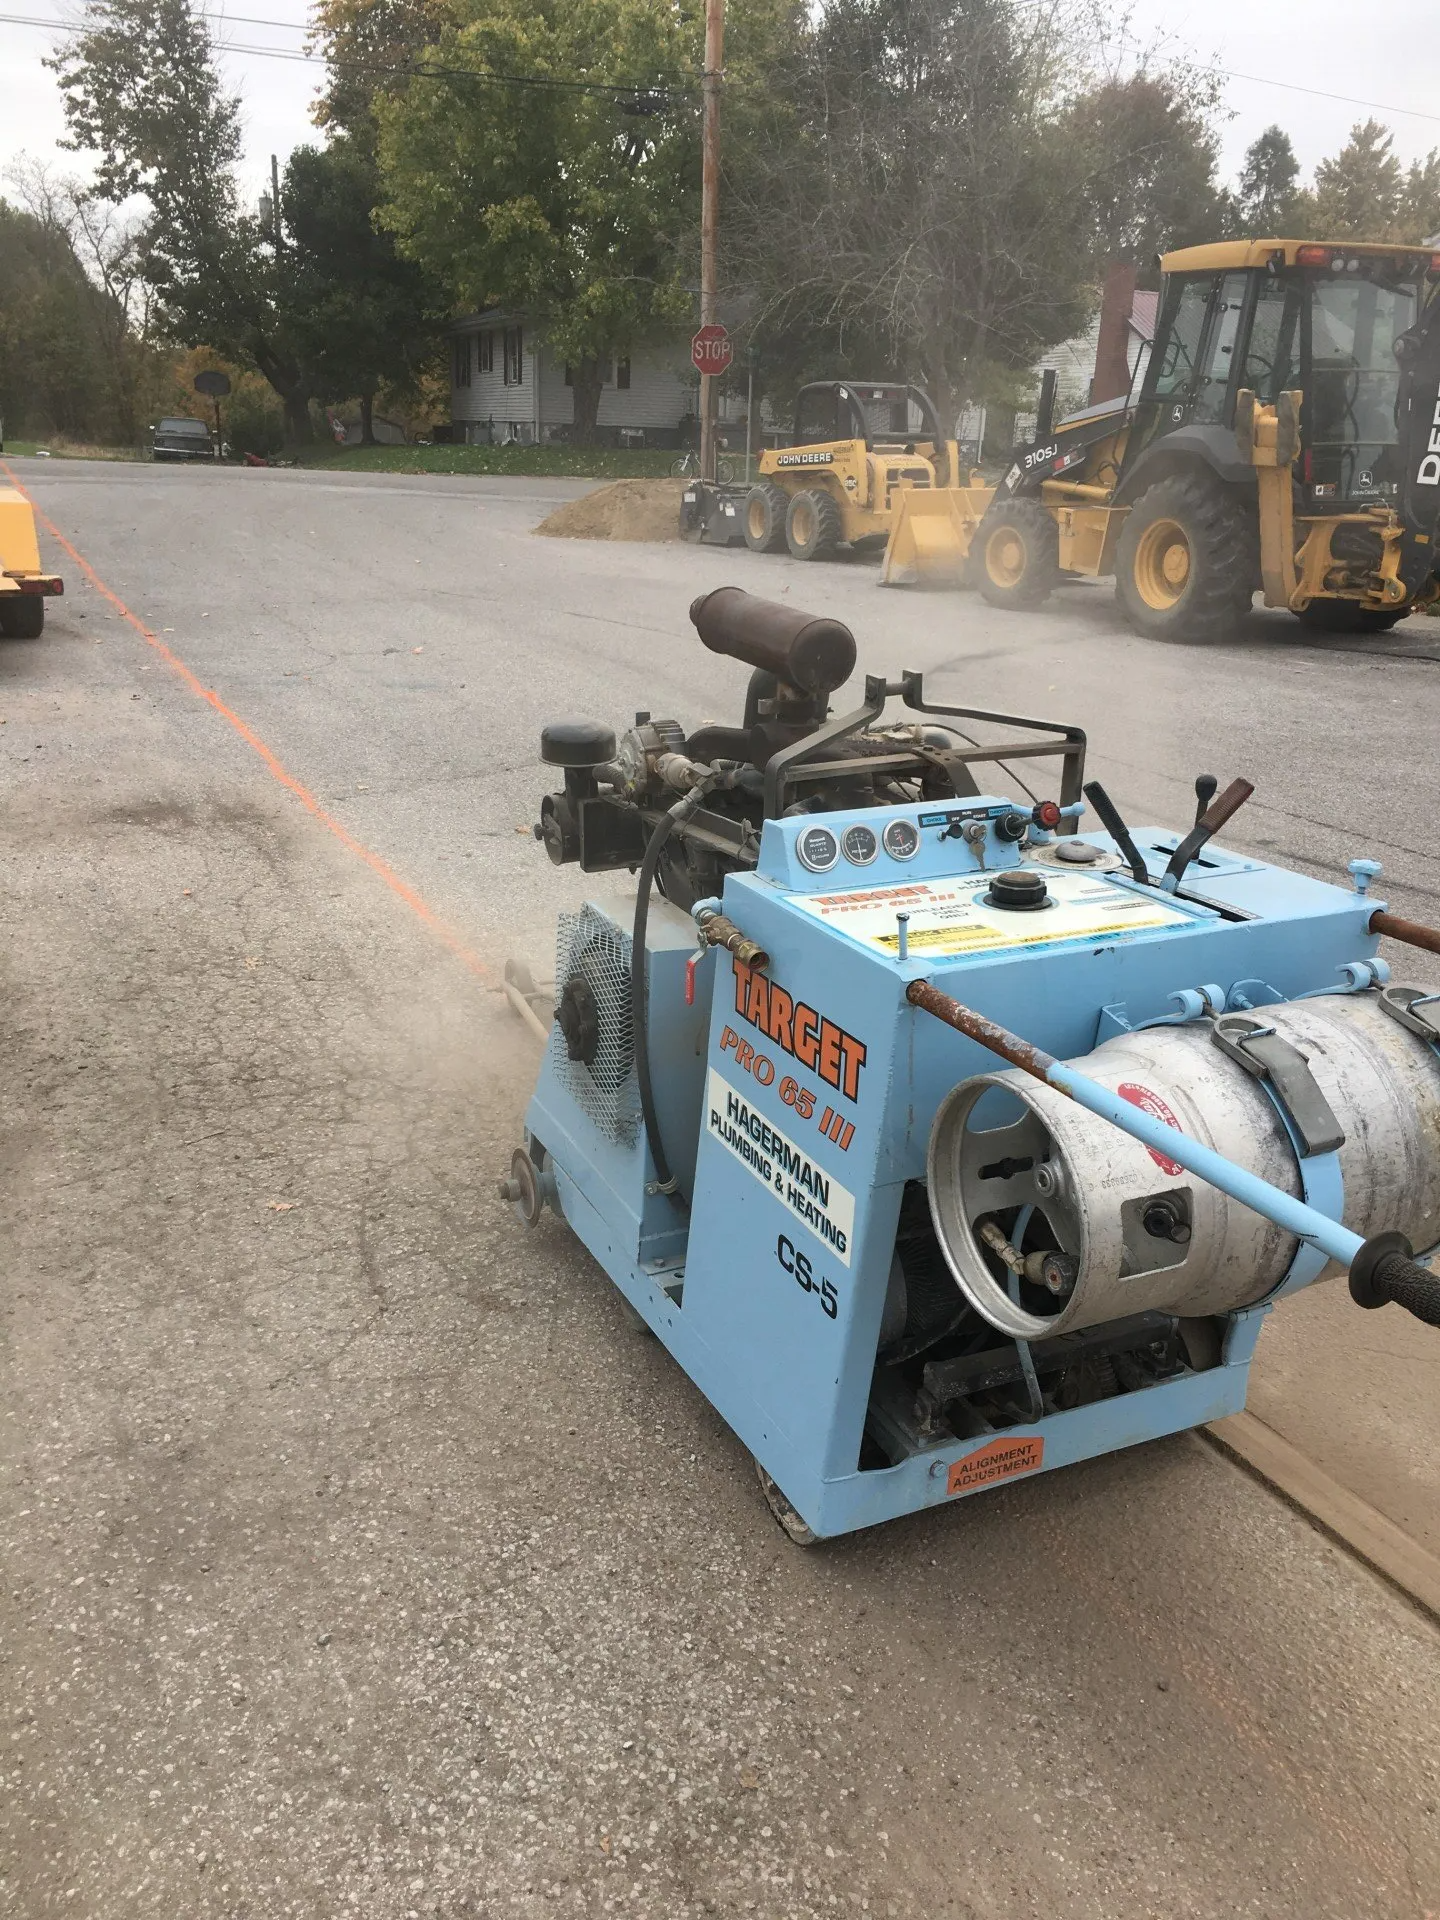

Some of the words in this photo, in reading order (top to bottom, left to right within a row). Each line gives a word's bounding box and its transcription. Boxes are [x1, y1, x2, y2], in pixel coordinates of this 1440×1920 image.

[695, 341, 730, 360] STOP
[778, 455, 801, 465] JOHN
[802, 453, 832, 463] DEERE
[1024, 443, 1058, 469] 310SJ
[809, 885, 933, 906] TARGET
[821, 902, 883, 914] PRO
[889, 898, 922, 907] 65
[929, 893, 956, 902] III
[908, 903, 972, 914] UNLEADED
[733, 955, 867, 1104] TARGET
[719, 1025, 775, 1086] PRO
[778, 1076, 817, 1120] 65
[818, 1106, 856, 1151] III
[727, 1090, 830, 1208] HAGERMAN
[711, 1109, 772, 1181] PLUMBING
[775, 1172, 784, 1195] &
[787, 1182, 847, 1254] HEATING
[777, 1233, 838, 1320] CS-5
[953, 1454, 1038, 1488] ADJUSTMENT
[960, 1444, 1034, 1475] ALIGNMENT
